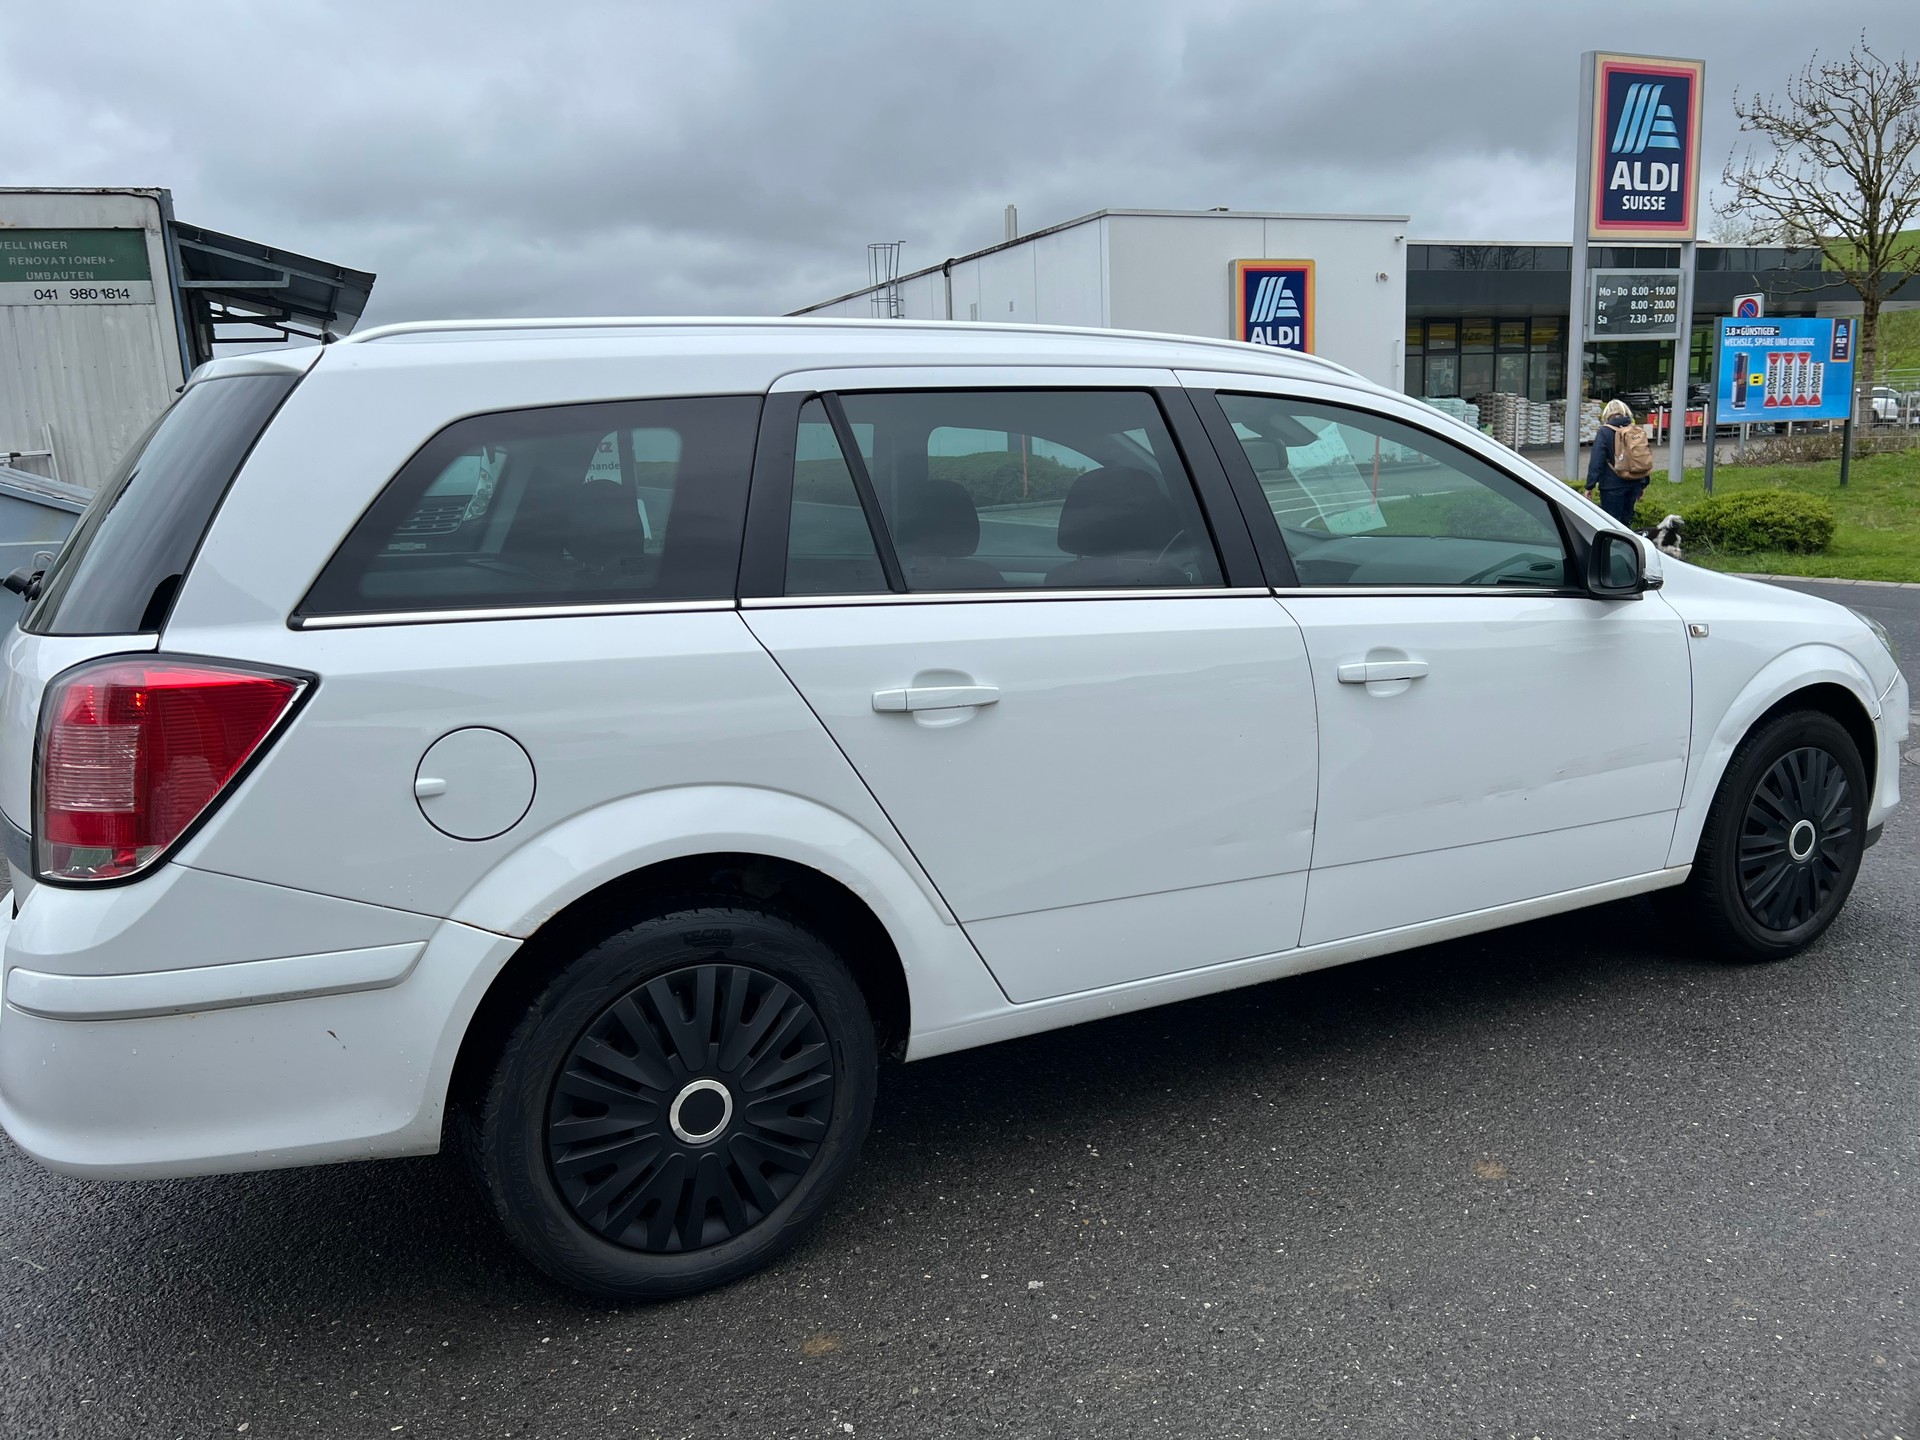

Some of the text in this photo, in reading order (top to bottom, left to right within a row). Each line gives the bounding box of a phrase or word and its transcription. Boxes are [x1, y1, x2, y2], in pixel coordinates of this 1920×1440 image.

[1610, 161, 1679, 191] ALDI
[1622, 195, 1666, 211] SUISSE
[0, 241, 68, 250] ELLINGER
[26, 271, 94, 280] UMBAUTEN
[34, 289, 58, 300] 041
[1599, 286, 1611, 296] Mo
[1617, 286, 1628, 296] Do
[1631, 286, 1649, 296] 8.00
[1655, 286, 1676, 296] 19.00
[1598, 301, 1606, 310] Fr
[1630, 300, 1648, 310] 8.00
[1653, 300, 1675, 310] 20.00
[1597, 315, 1608, 324] Sa
[1629, 314, 1647, 324] 7.30
[1653, 313, 1675, 323] 17.00
[1250, 326, 1300, 345] ALDI
[1754, 338, 1774, 346] SPARE
[1775, 338, 1788, 346] UND
